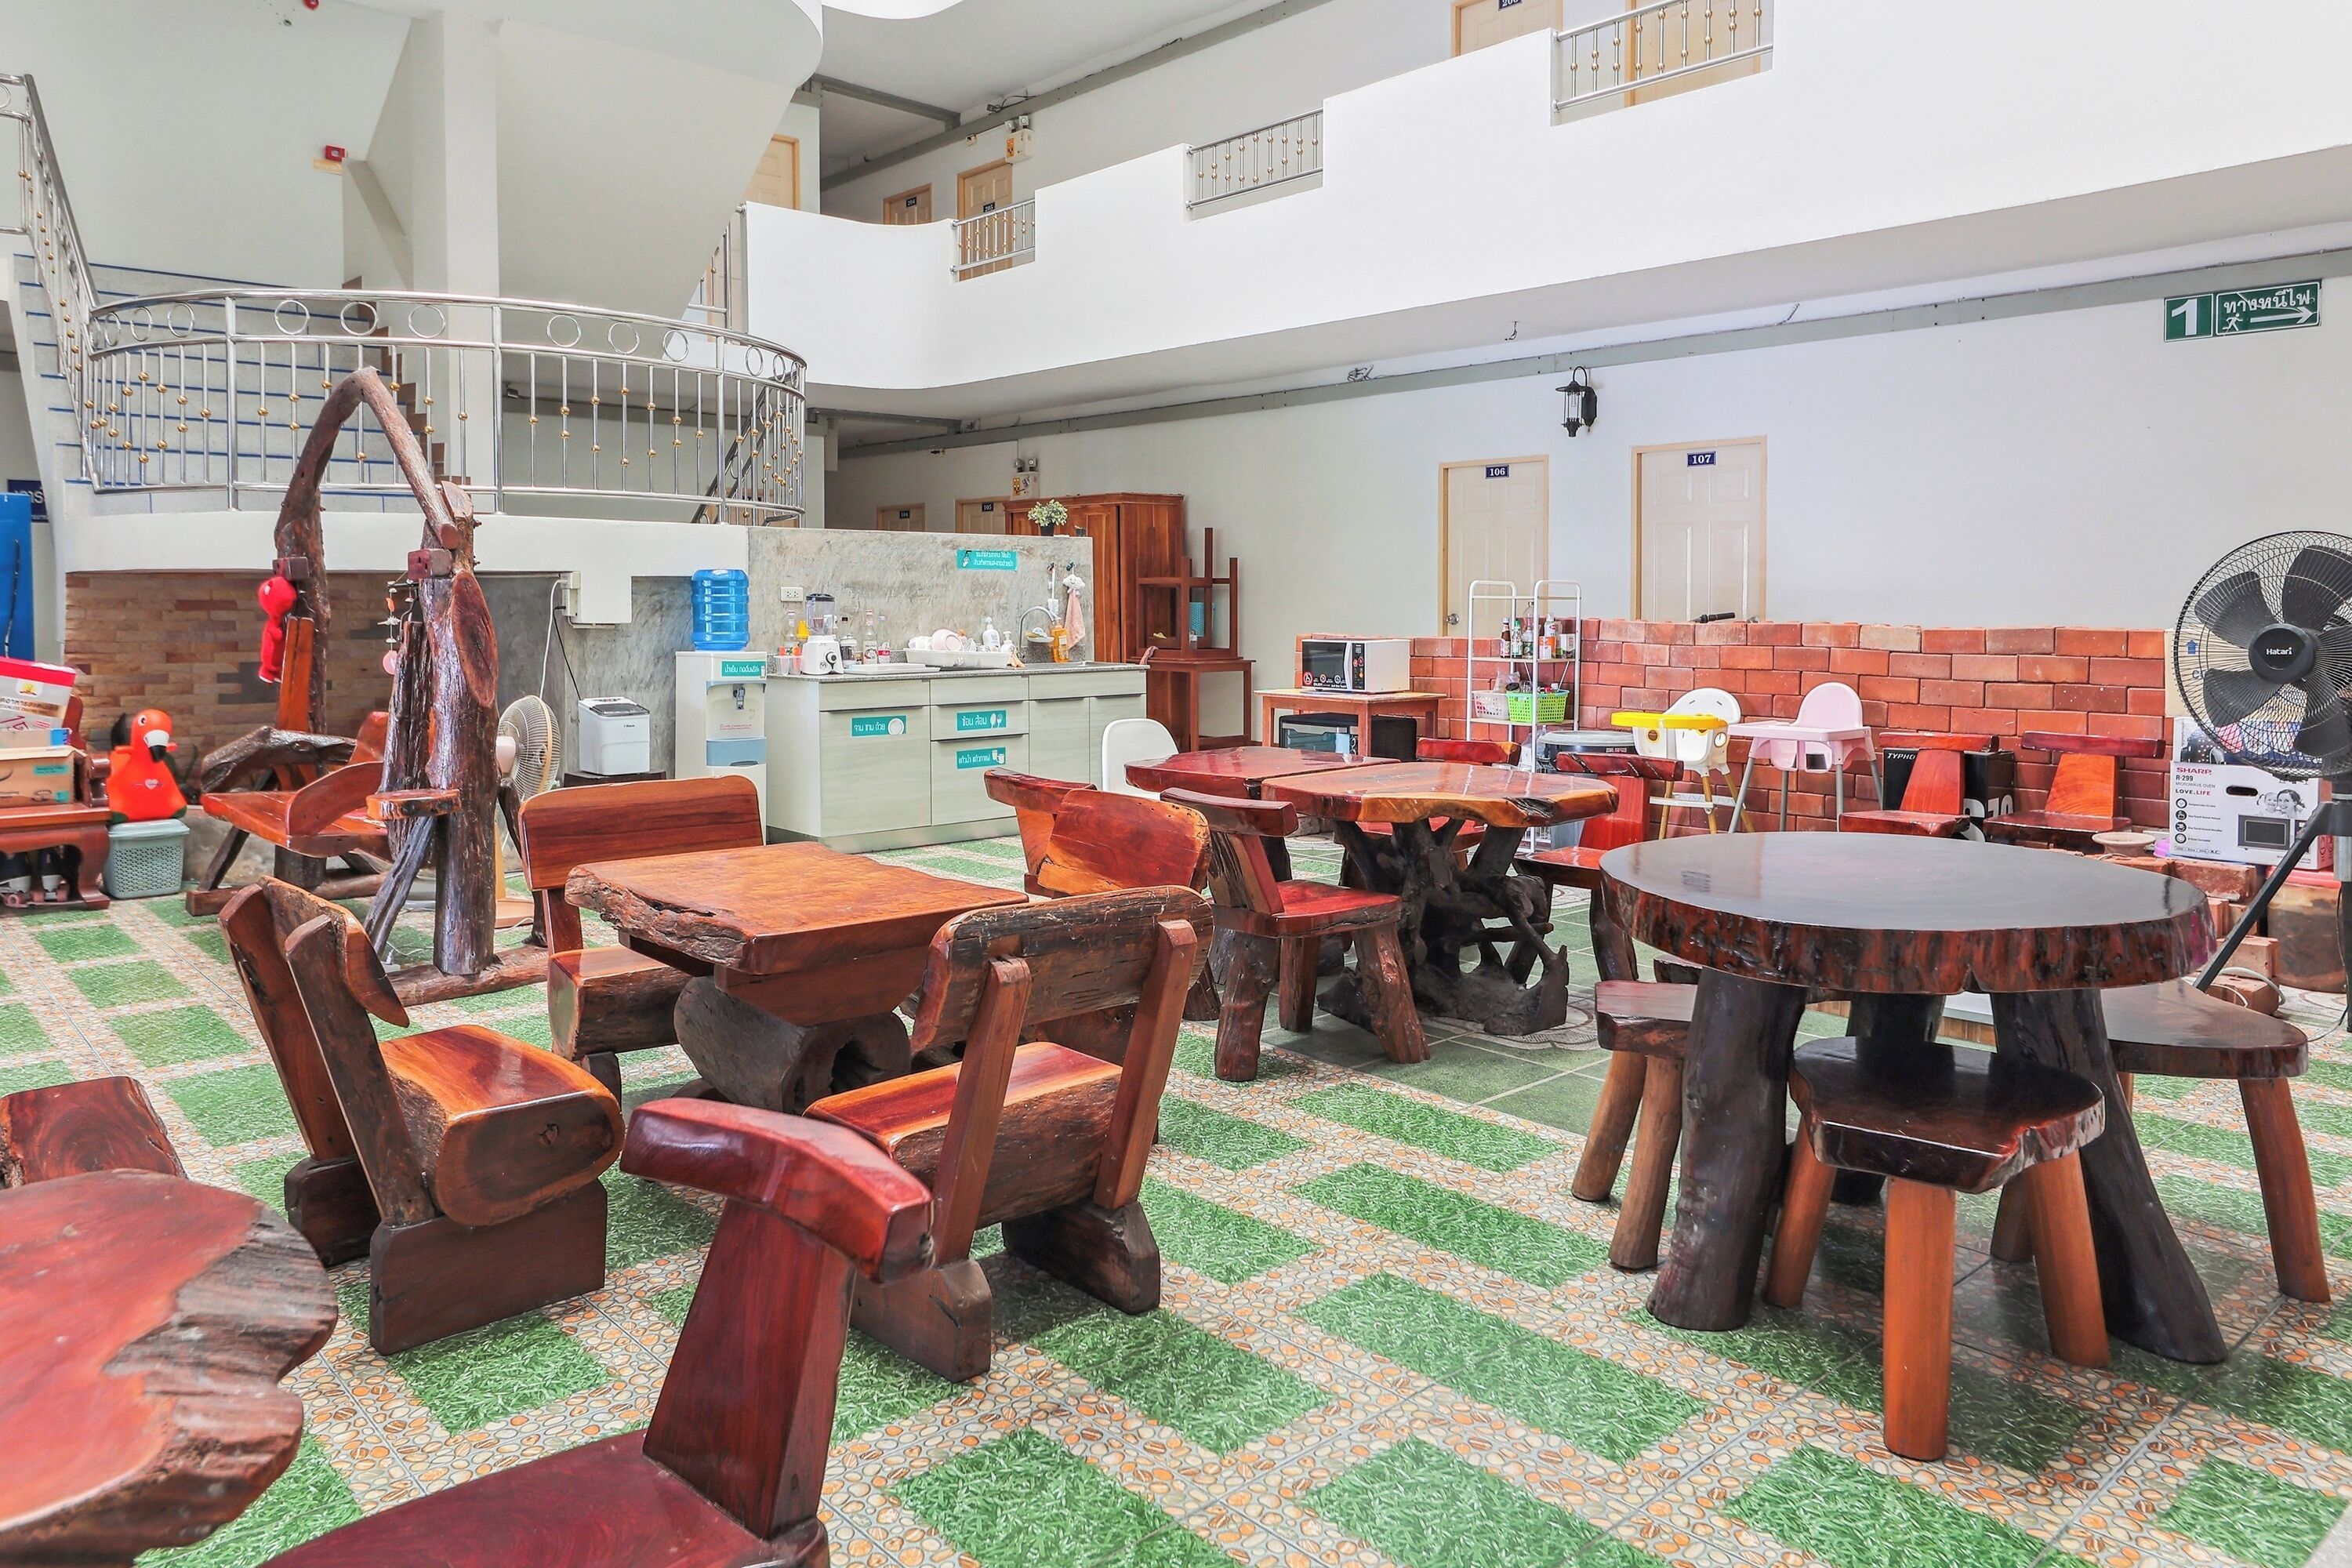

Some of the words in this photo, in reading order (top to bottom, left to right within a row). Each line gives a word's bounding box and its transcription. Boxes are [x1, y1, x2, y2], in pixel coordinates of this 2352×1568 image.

[2223, 288, 2310, 314] ทางหนีไฟ
[2171, 299, 2198, 336] 1
[1692, 455, 1711, 464] 107
[1490, 467, 1506, 476] 106
[2266, 647, 2292, 655] Hatari
[961, 715, 974, 727] ช้อน
[975, 714, 987, 726] ส้อม
